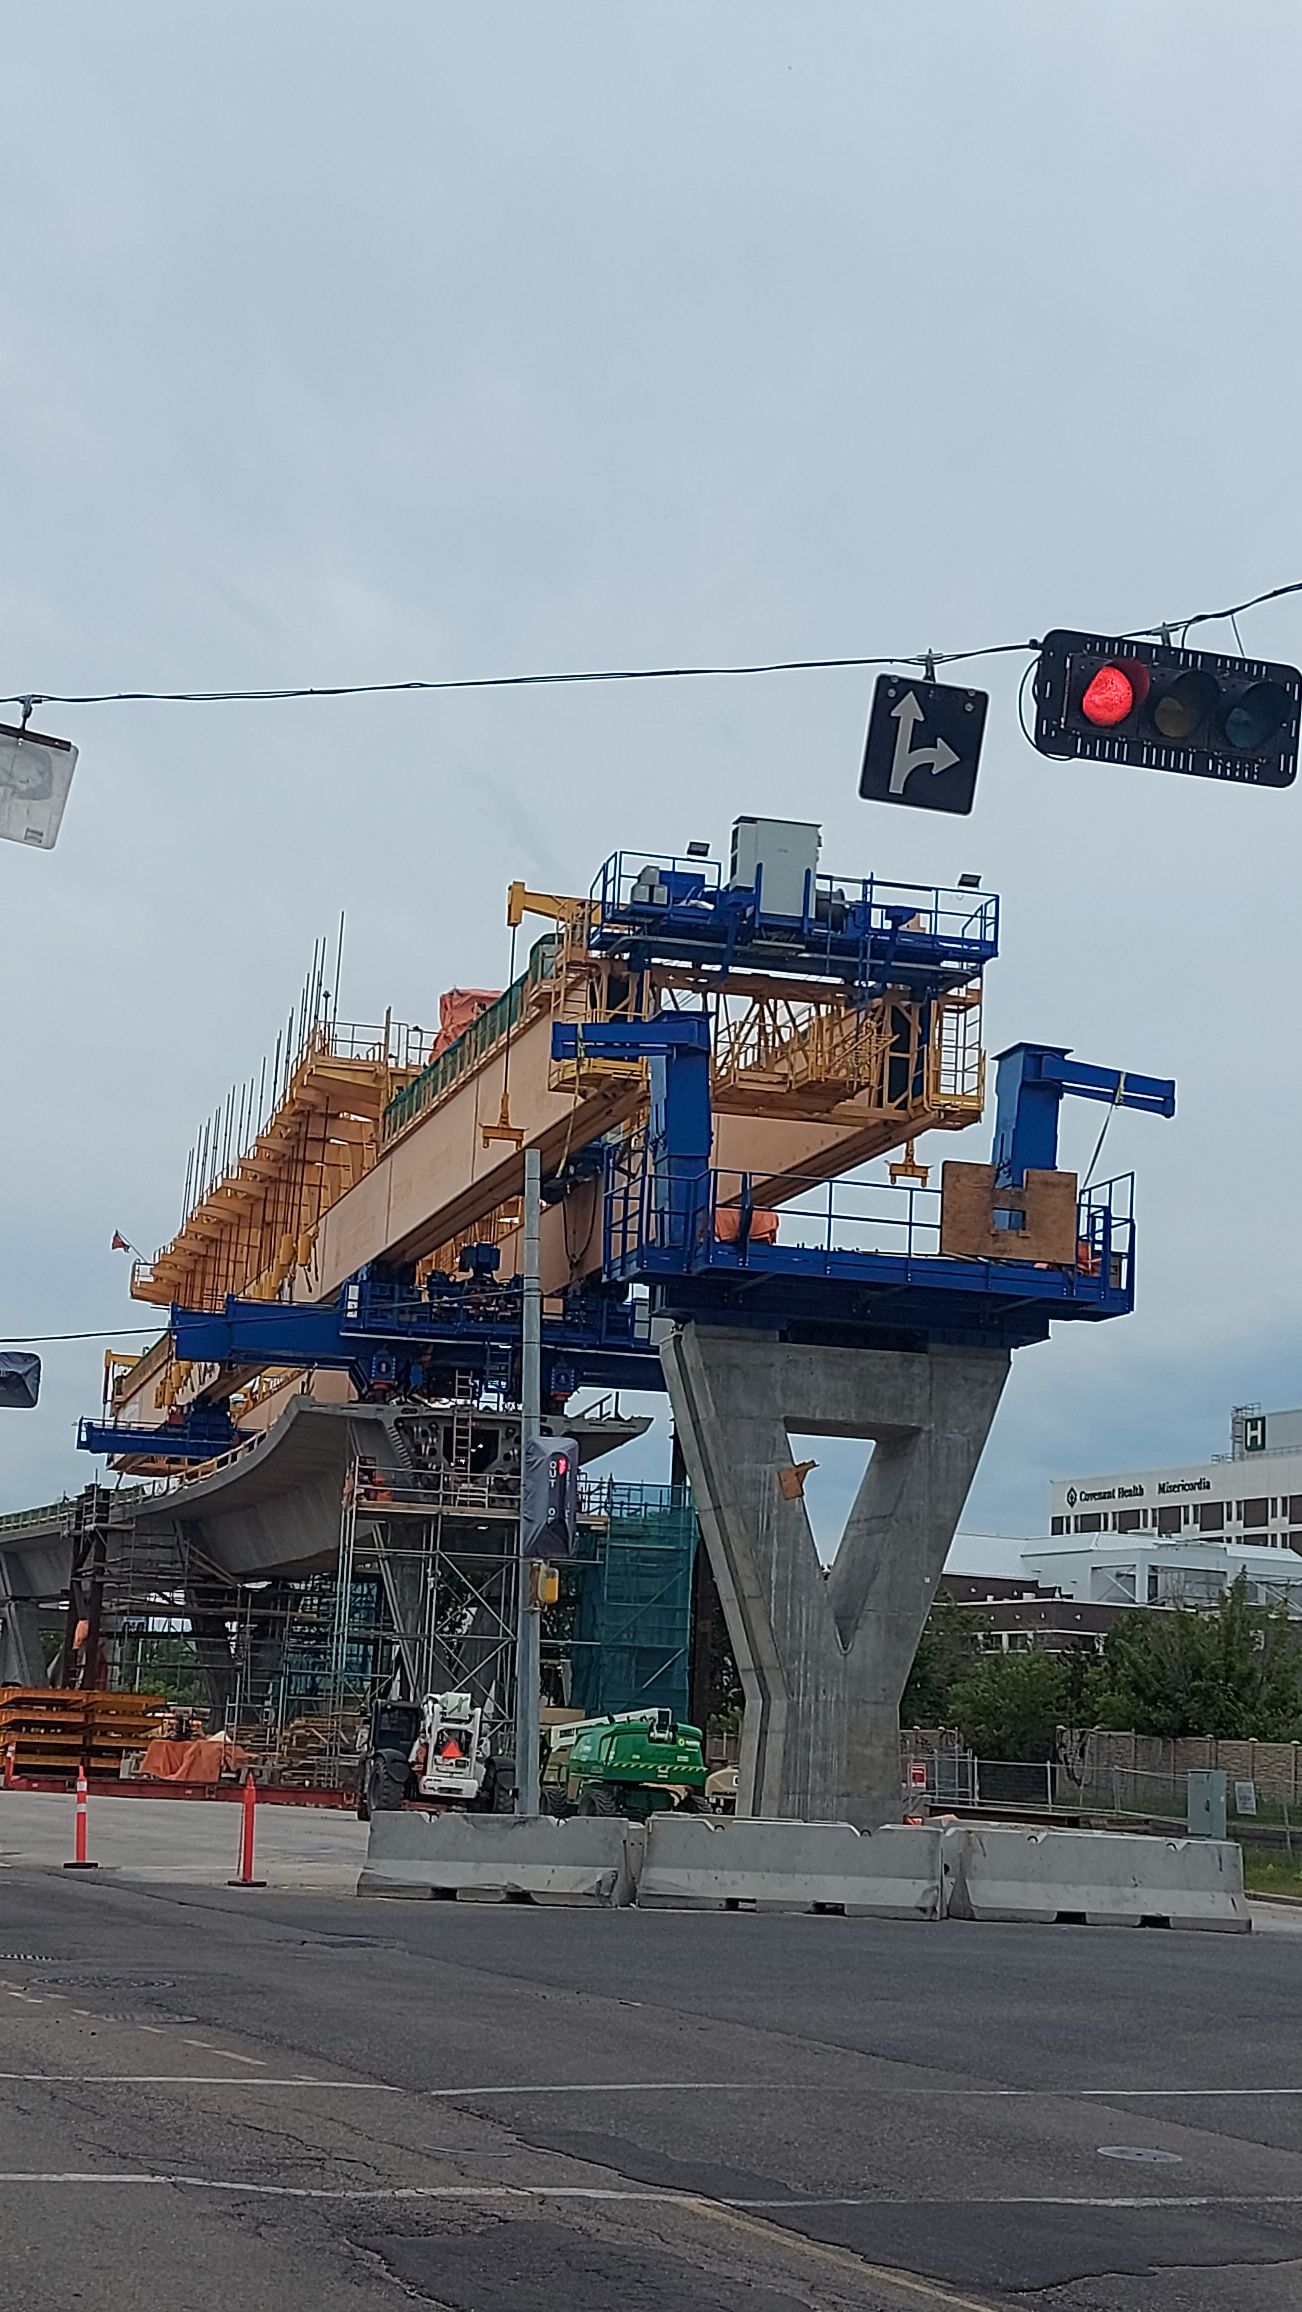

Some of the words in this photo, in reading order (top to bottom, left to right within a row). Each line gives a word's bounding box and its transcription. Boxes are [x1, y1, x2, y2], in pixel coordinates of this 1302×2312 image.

[1247, 1420, 1262, 1446] H
[549, 1461, 557, 1488] OUT
[1080, 1488, 1115, 1502] Covenant
[1118, 1484, 1144, 1499] Health
[1158, 1478, 1211, 1494] Misericordia
